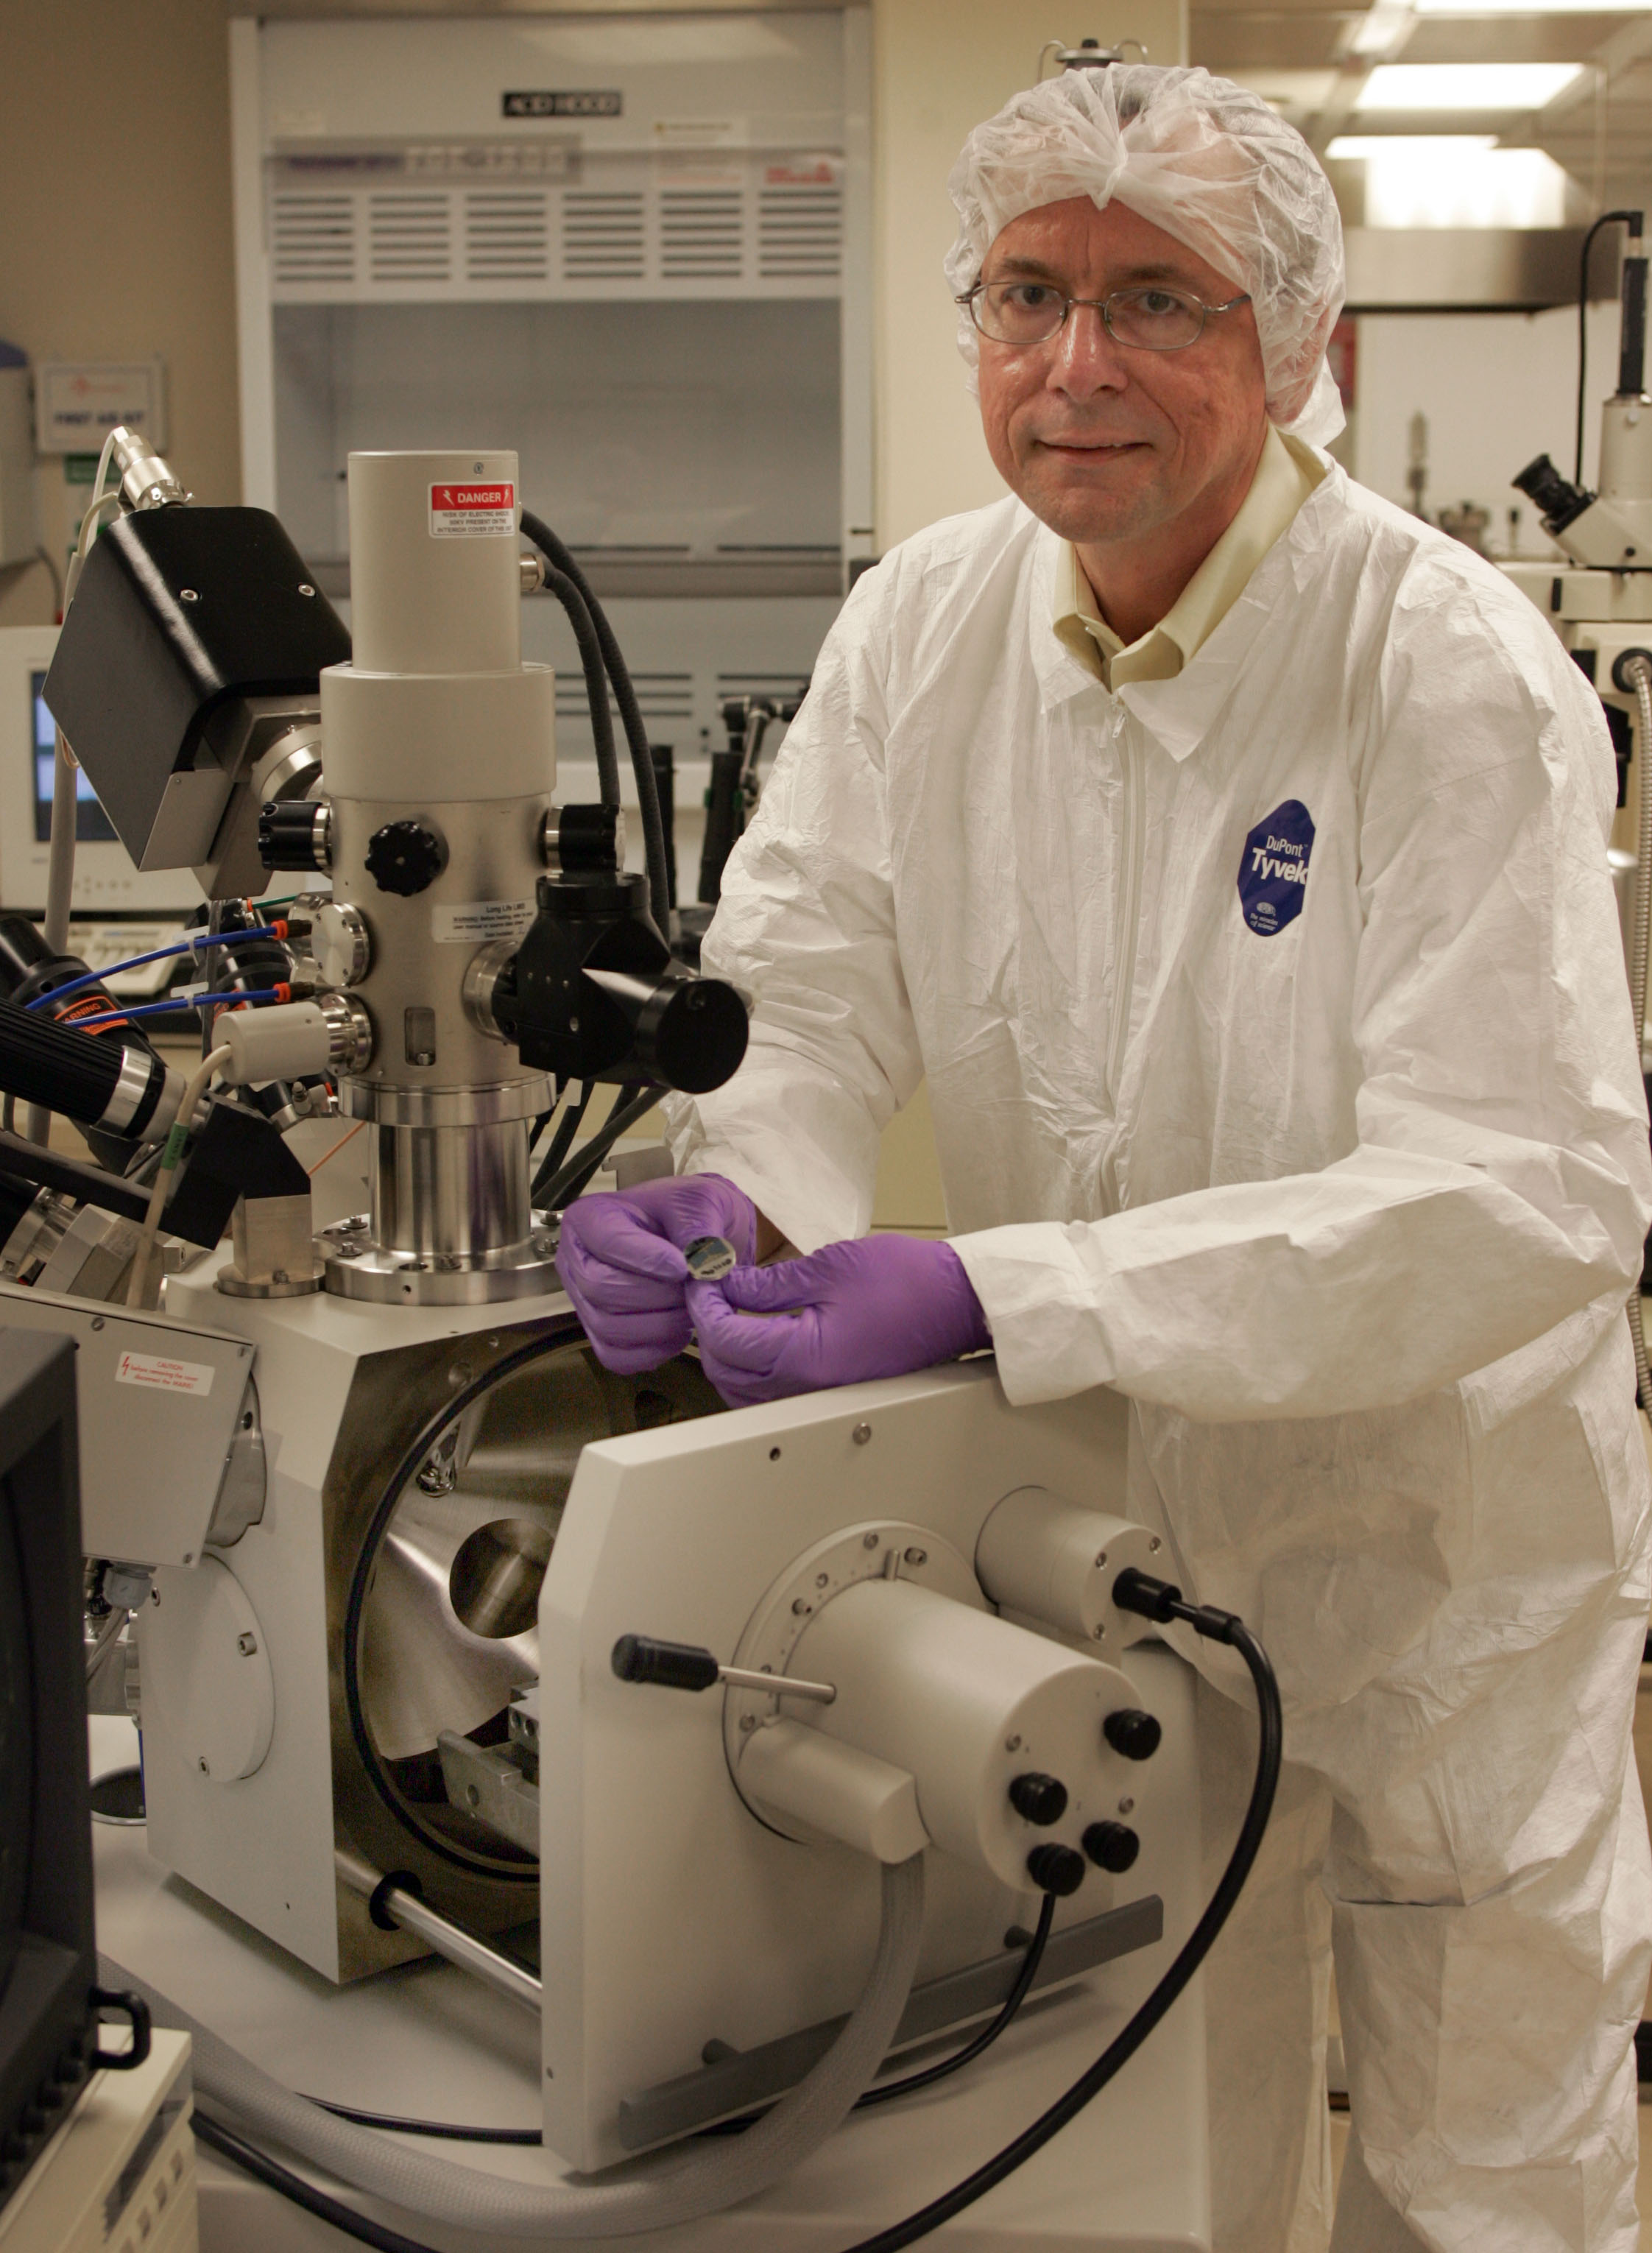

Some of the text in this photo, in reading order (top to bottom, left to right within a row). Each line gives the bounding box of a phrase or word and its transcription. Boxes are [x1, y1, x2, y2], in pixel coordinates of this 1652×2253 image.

[457, 492, 501, 504] DANGER
[1266, 835, 1303, 858] DuPont
[1252, 847, 1309, 885] Tyvek
[64, 1004, 101, 1022] ARNING
[130, 1365, 148, 1373] before
[149, 1369, 174, 1379] removing
[157, 1361, 183, 1371] CAUTION
[135, 1374, 160, 1383] disconnect
